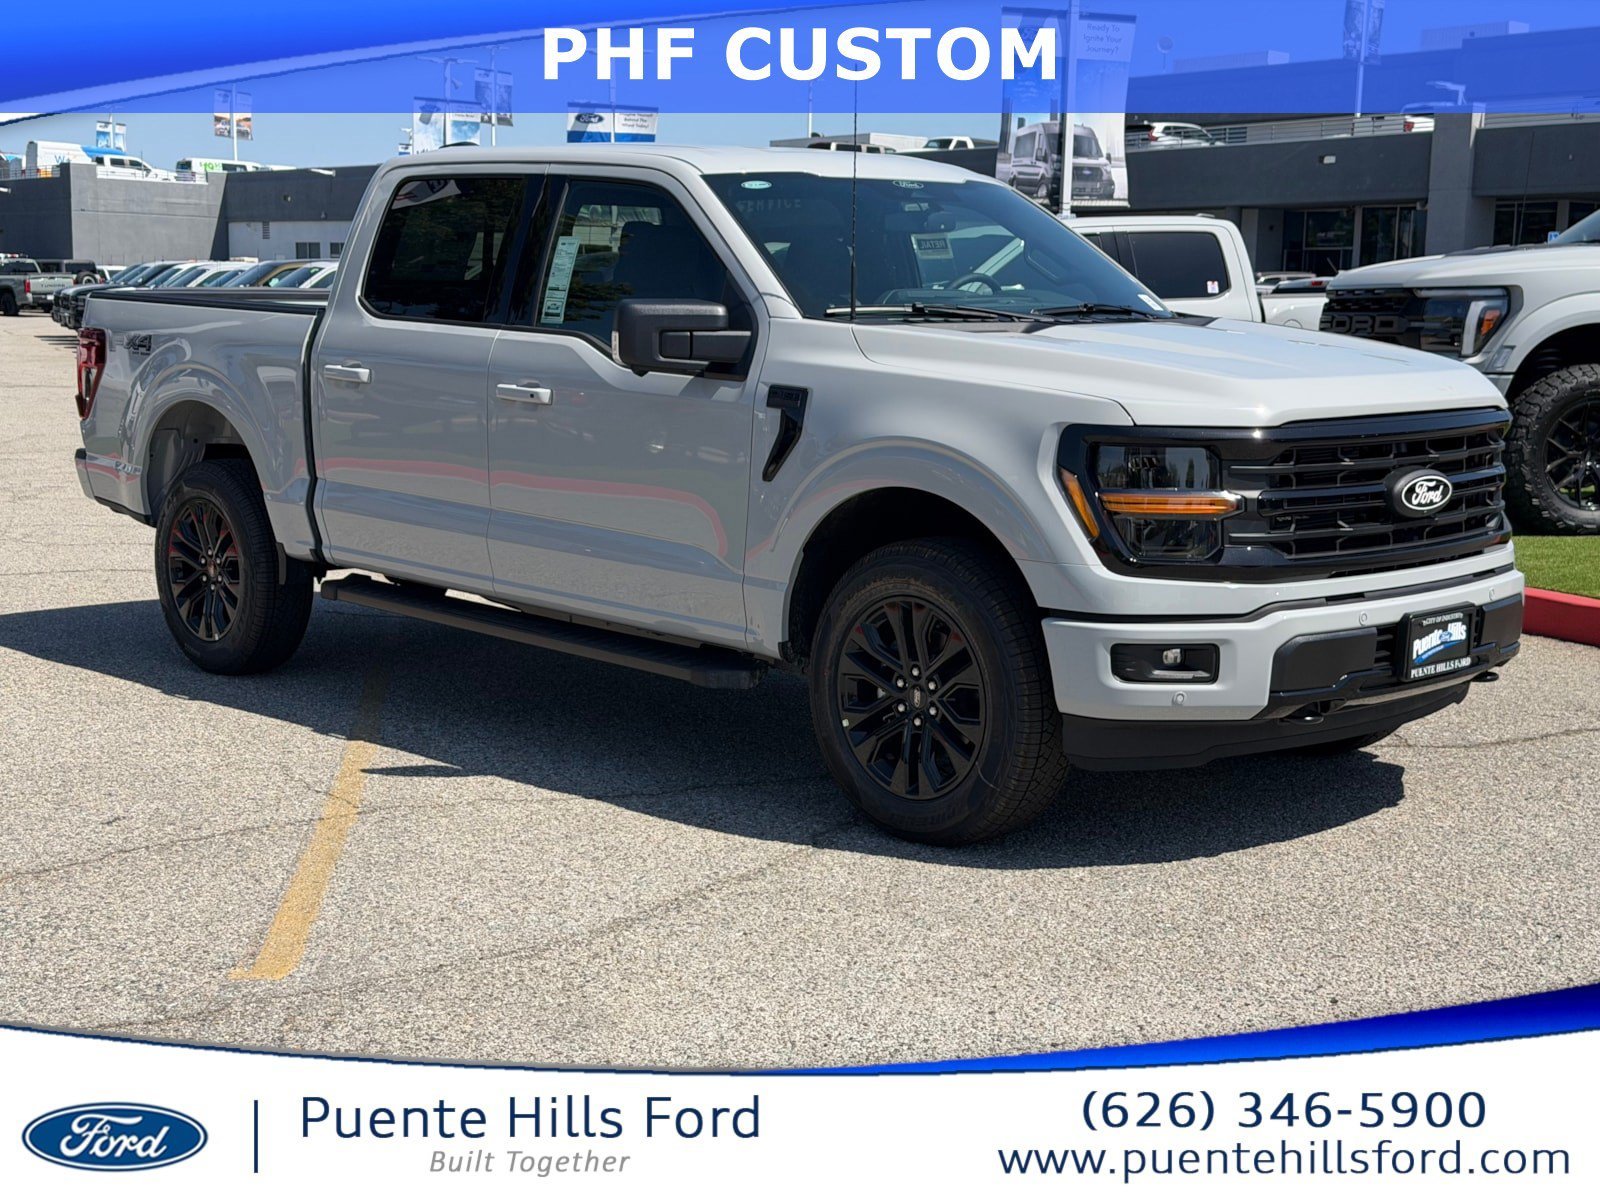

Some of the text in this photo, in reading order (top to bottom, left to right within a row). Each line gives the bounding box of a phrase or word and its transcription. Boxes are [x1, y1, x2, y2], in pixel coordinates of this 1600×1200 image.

[1087, 23, 1121, 33] Ready To
[1083, 33, 1122, 43] Ignite Your
[1085, 45, 1119, 56] Journey?
[1411, 480, 1445, 506] Ford
[1412, 628, 1444, 660] Puente
[1447, 621, 1467, 641] Hills
[1410, 656, 1471, 679] PUENTE HILLS FORD
